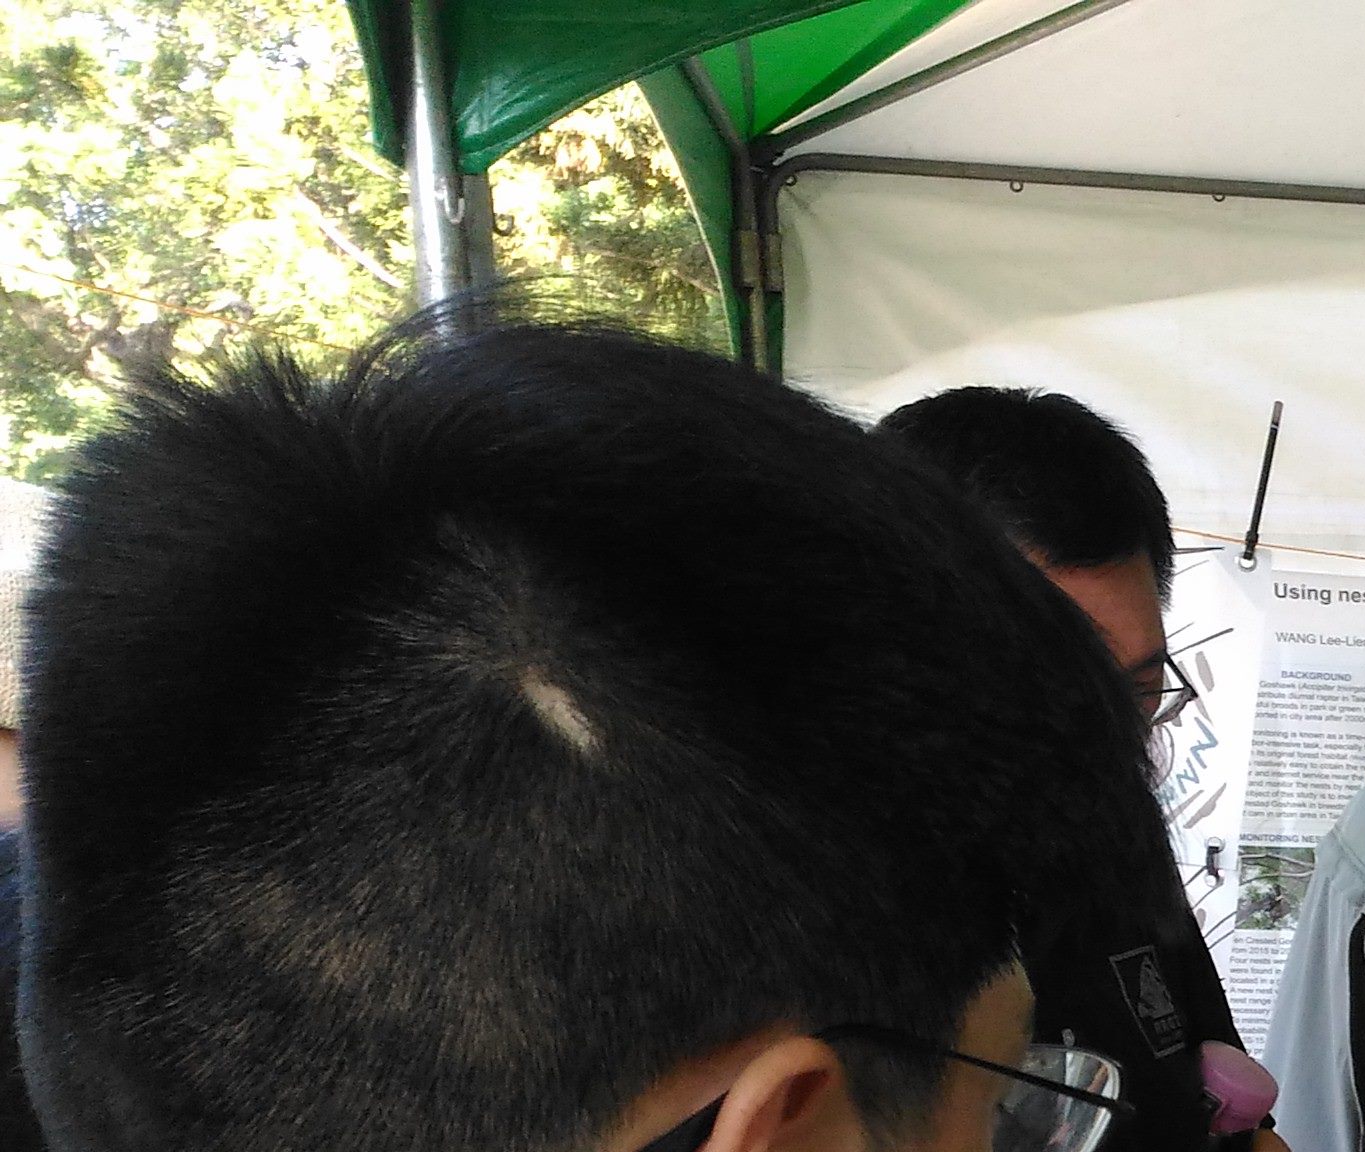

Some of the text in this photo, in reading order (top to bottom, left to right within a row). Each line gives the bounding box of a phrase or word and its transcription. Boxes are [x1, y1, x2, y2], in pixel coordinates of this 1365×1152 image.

[1274, 582, 1331, 604] Using
[1276, 632, 1316, 644] WANG
[1281, 671, 1352, 682] BACKGROUND
[1239, 834, 1320, 843] MONITORING NES
